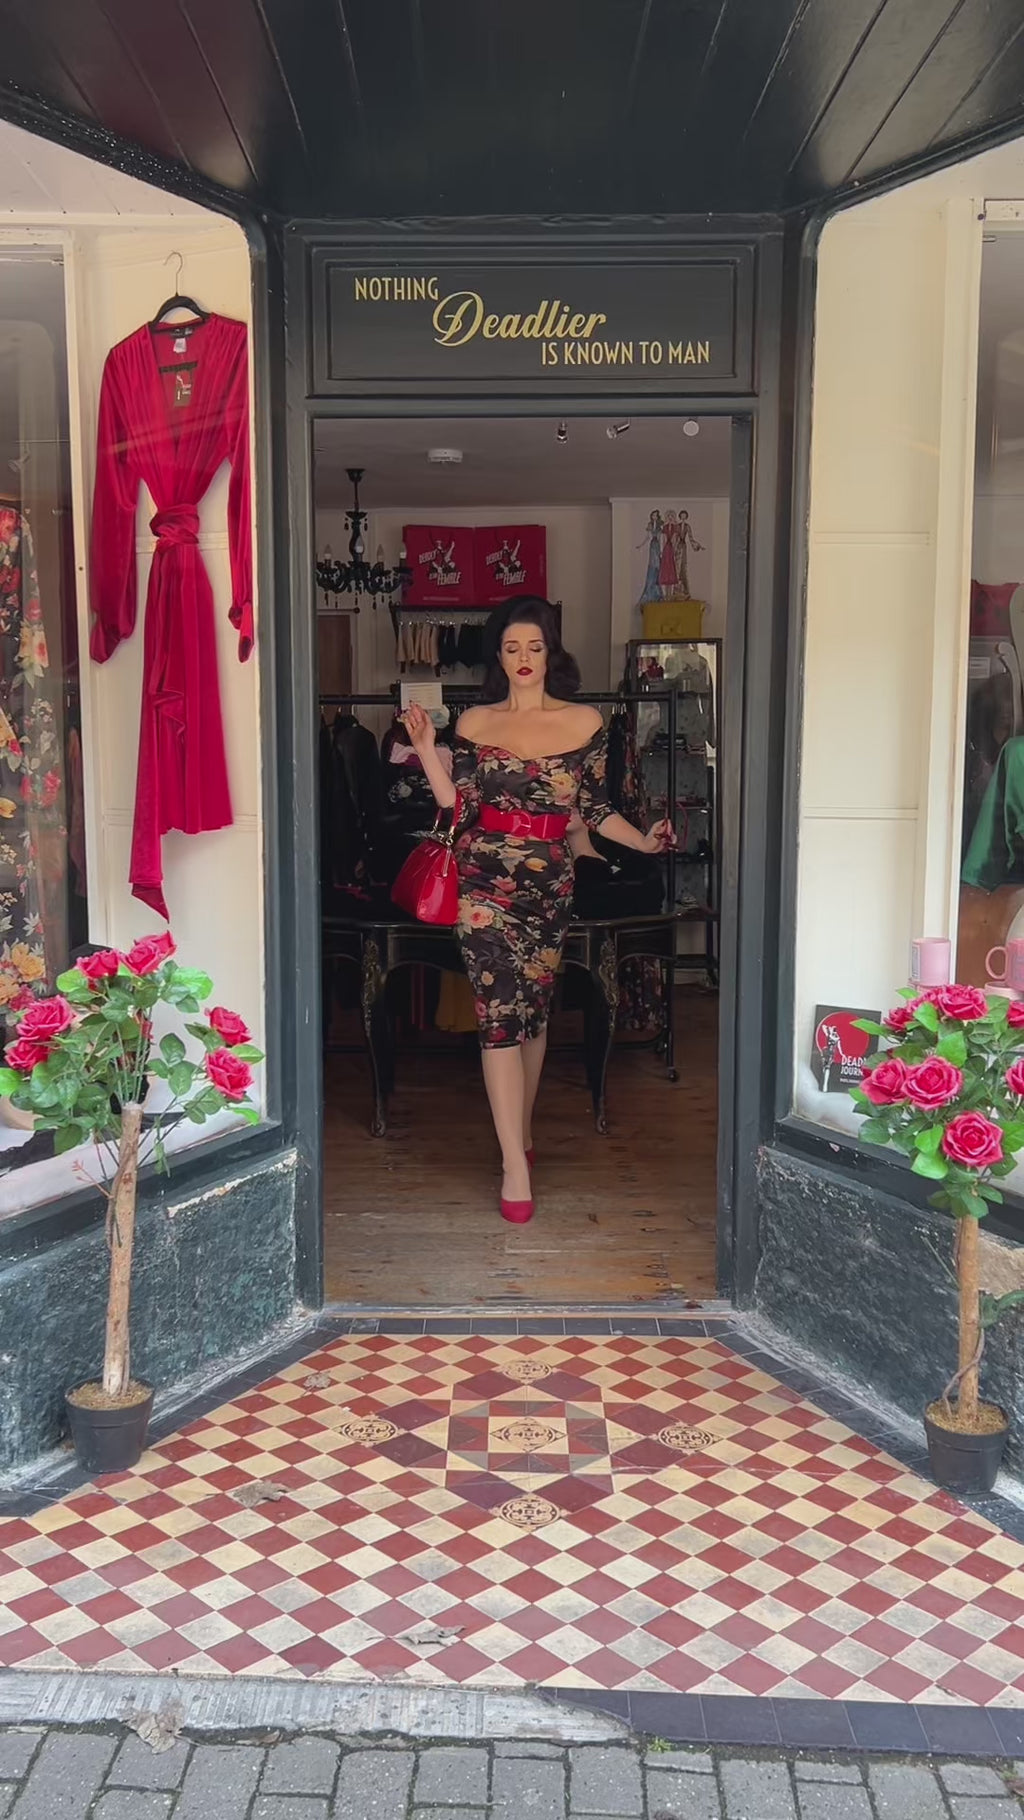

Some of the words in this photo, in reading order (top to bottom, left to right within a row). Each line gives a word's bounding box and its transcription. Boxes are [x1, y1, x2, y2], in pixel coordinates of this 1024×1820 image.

[354, 277, 439, 301] NOTHING
[432, 291, 607, 347] Deadlier
[541, 342, 558, 366] IS
[564, 342, 634, 366] KNOWN
[639, 342, 662, 365] TO
[668, 341, 711, 365] MAN
